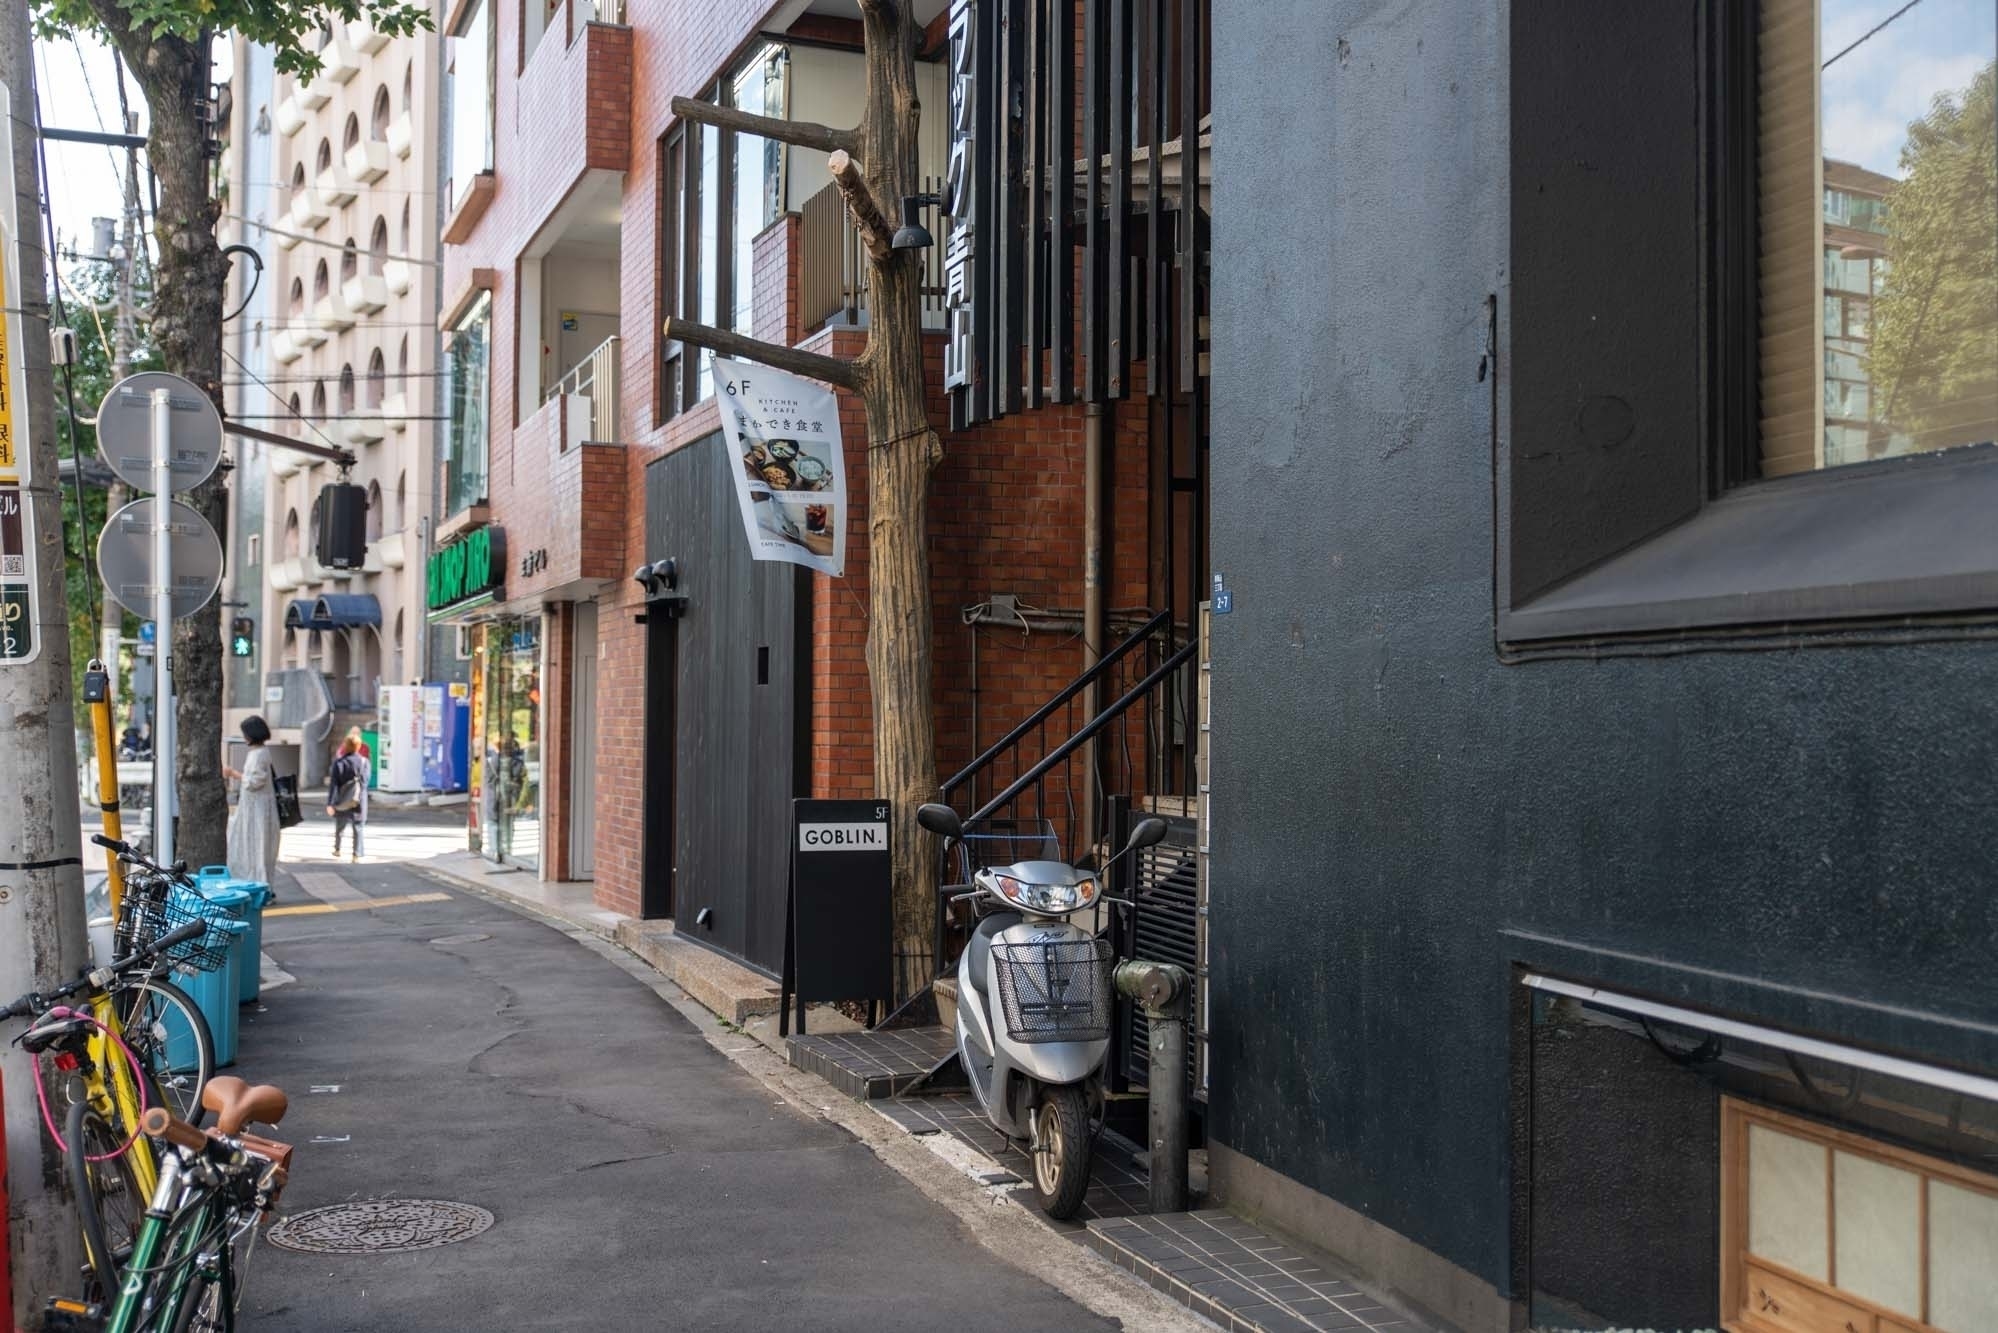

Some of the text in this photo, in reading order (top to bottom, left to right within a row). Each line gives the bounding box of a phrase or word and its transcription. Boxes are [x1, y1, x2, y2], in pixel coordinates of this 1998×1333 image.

[726, 380, 752, 396] 6F
[758, 399, 798, 407] KITCHEN
[875, 806, 889, 819] 5F
[805, 828, 883, 846] GOBLIN.
